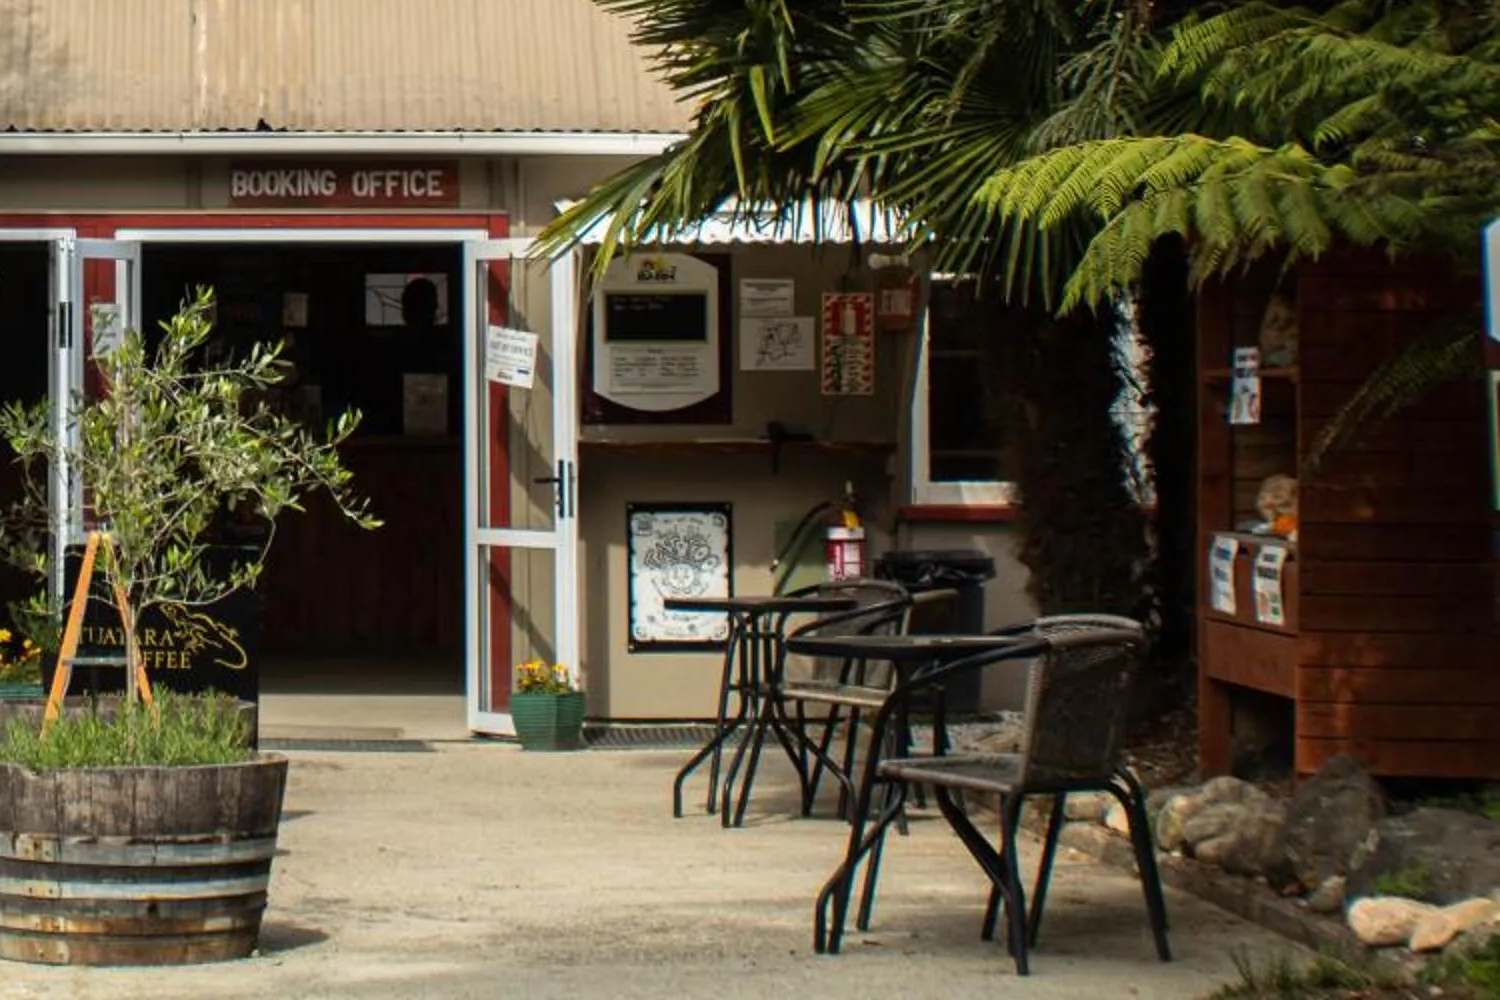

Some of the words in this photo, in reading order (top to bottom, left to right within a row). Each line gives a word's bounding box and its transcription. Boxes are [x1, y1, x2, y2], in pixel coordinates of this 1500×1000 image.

[231, 169, 337, 197] BOOKING
[352, 170, 443, 197] OFFICE
[142, 651, 192, 669] FFEE
